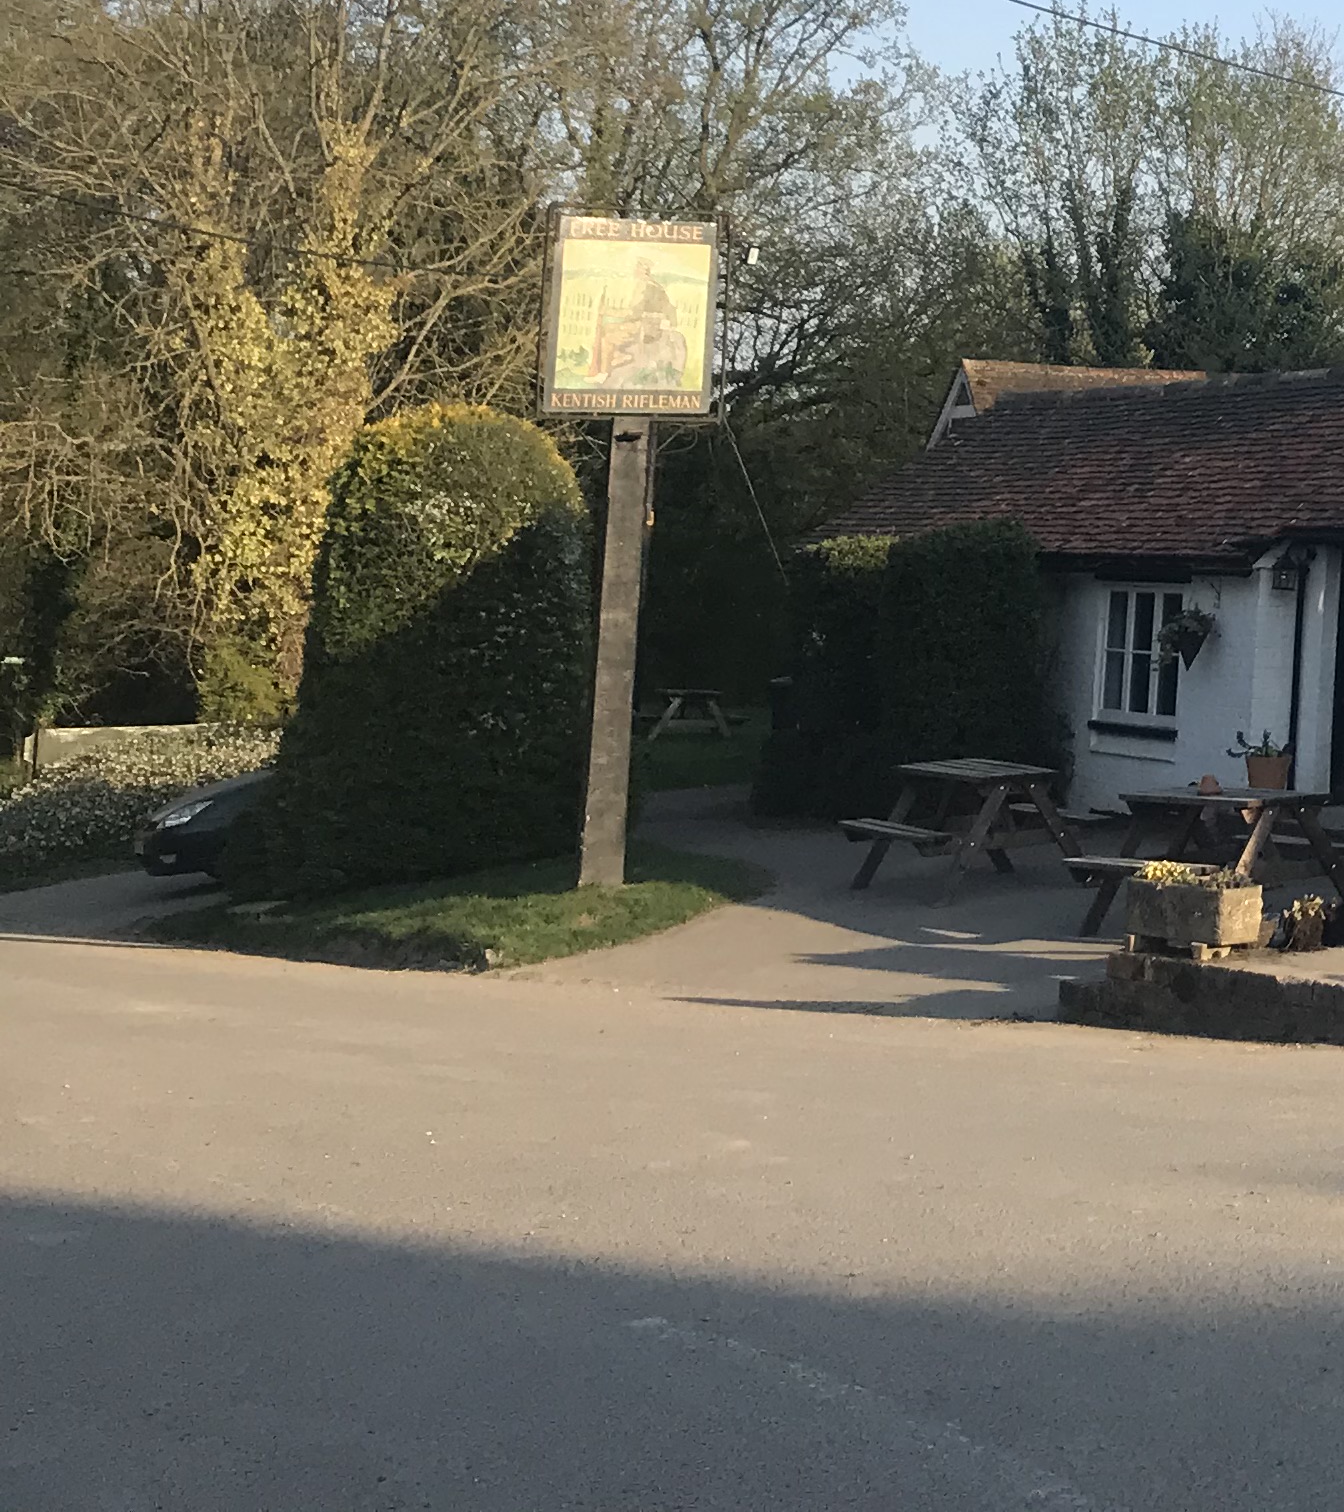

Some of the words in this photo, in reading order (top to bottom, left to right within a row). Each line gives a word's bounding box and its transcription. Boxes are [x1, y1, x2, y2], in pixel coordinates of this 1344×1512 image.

[570, 221, 620, 238] FREE
[631, 224, 703, 240] HOUSE
[551, 392, 617, 408] KENTISH
[622, 393, 701, 410] RIFLEMAN
